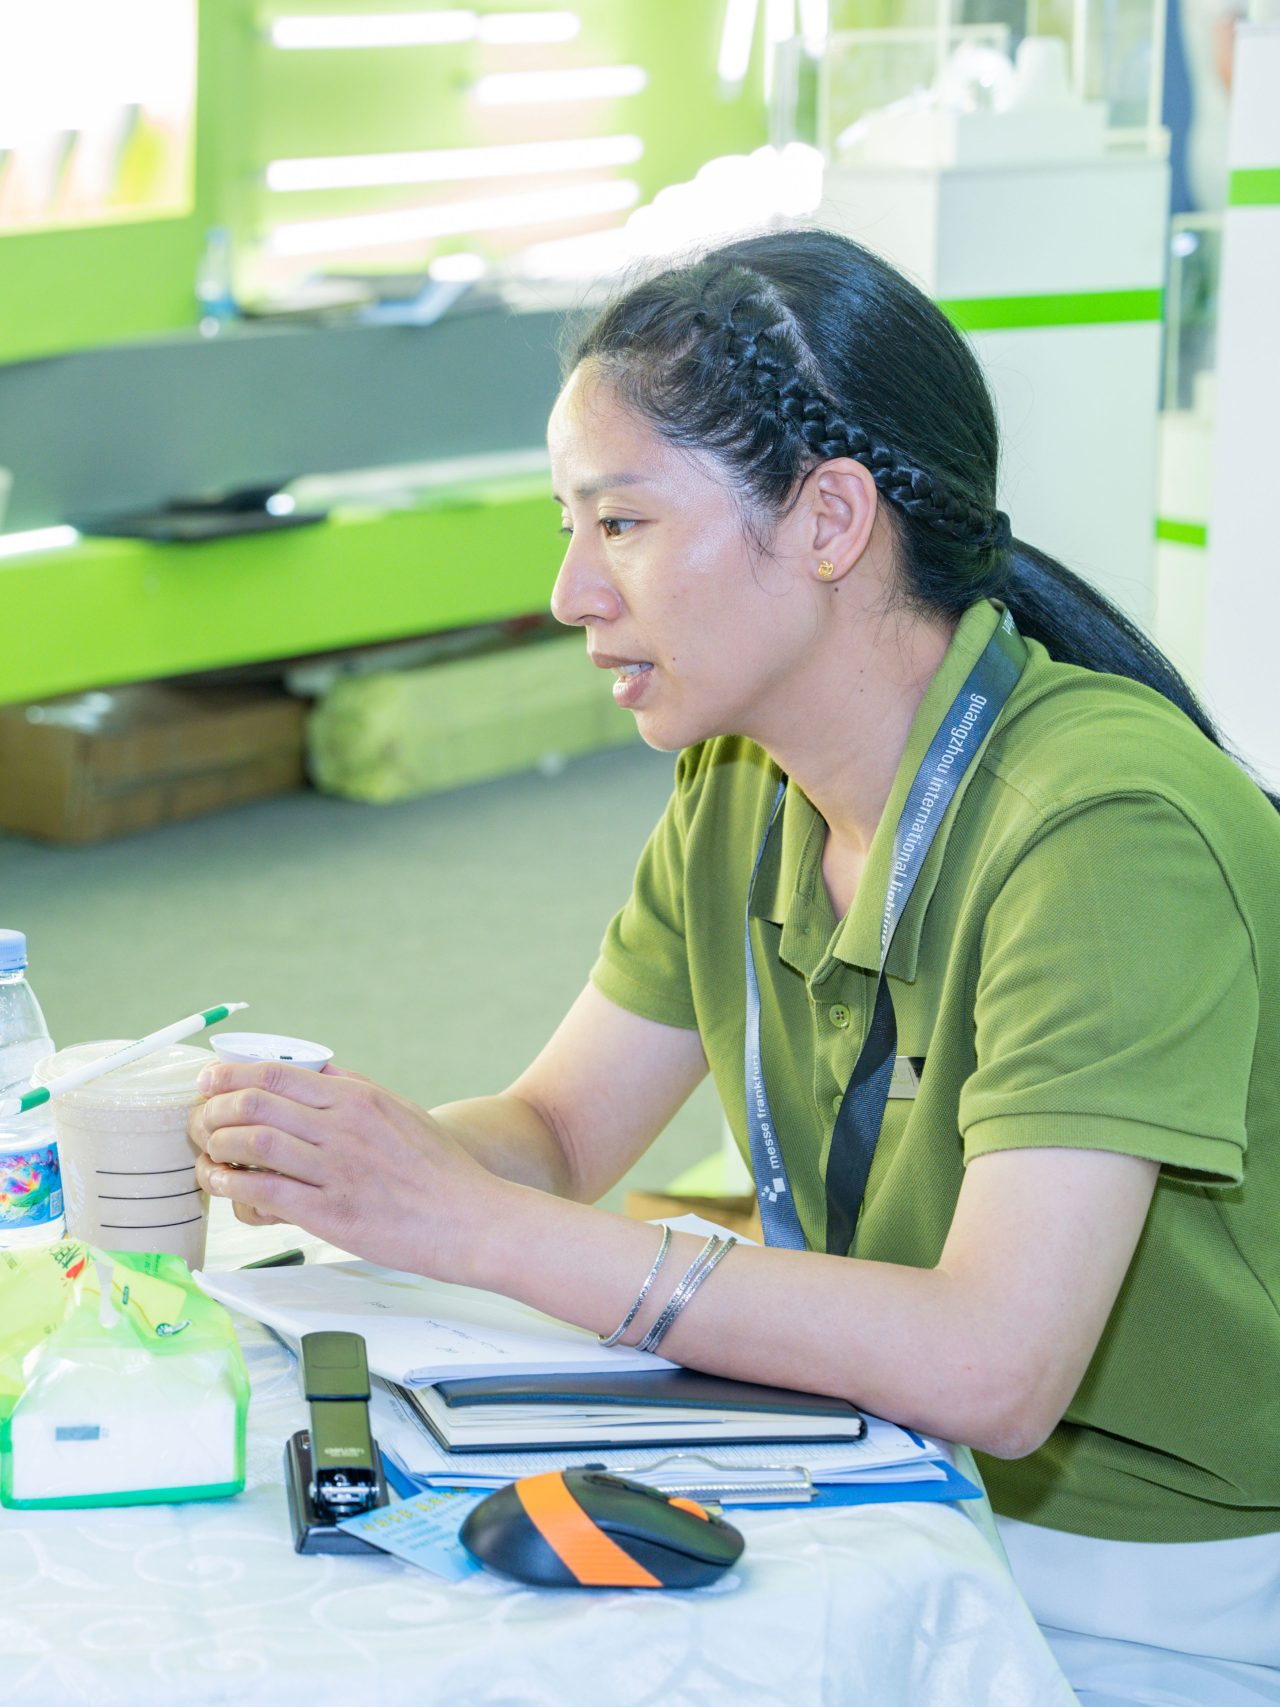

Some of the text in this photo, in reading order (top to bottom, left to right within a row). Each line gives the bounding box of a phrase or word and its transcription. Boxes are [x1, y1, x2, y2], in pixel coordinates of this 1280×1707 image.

[936, 693, 988, 775] guangzhou
[894, 779, 948, 877] international
[761, 1122, 780, 1170] messe
